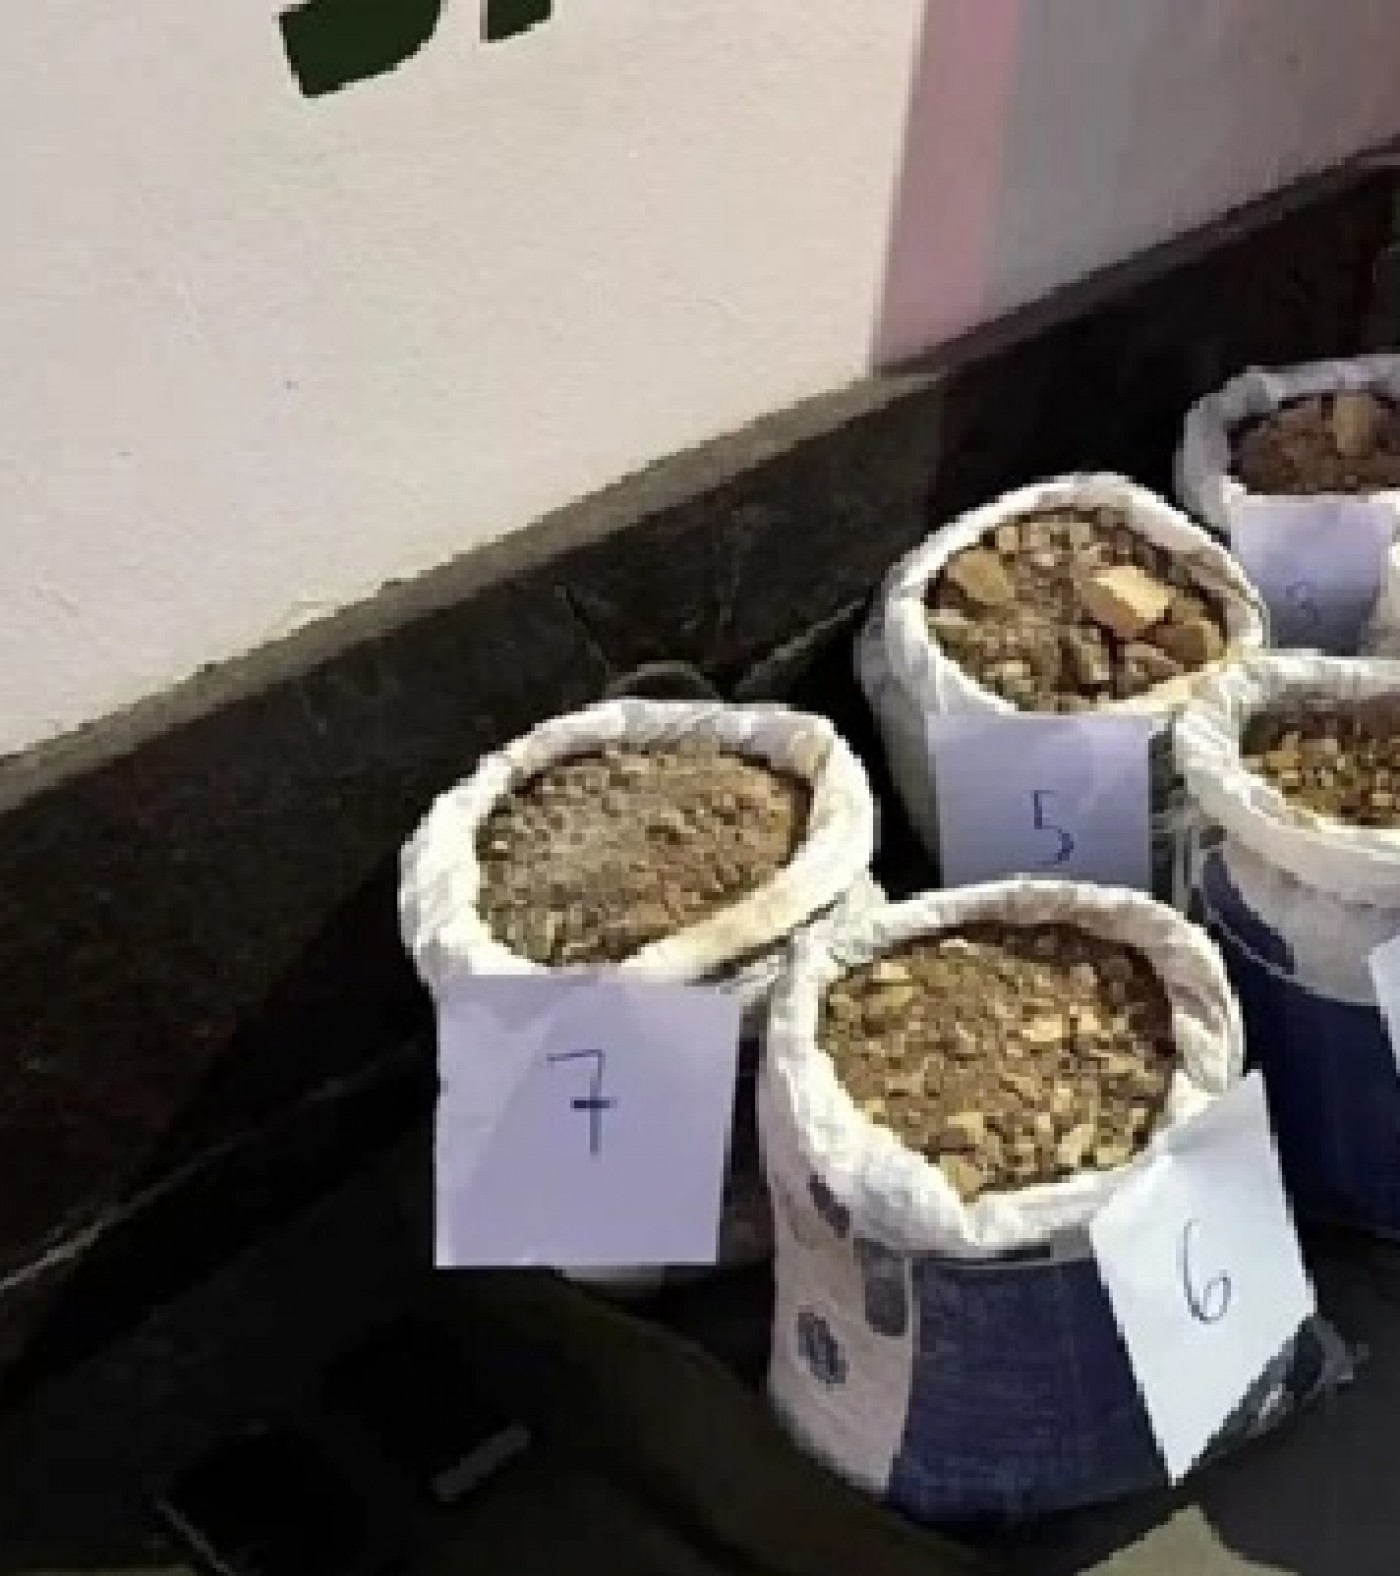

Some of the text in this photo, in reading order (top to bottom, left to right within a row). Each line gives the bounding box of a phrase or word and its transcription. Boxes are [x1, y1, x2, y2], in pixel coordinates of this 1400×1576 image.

[1028, 789, 1075, 866] 5
[546, 1048, 614, 1156] 7
[1180, 1215, 1233, 1324] 6
